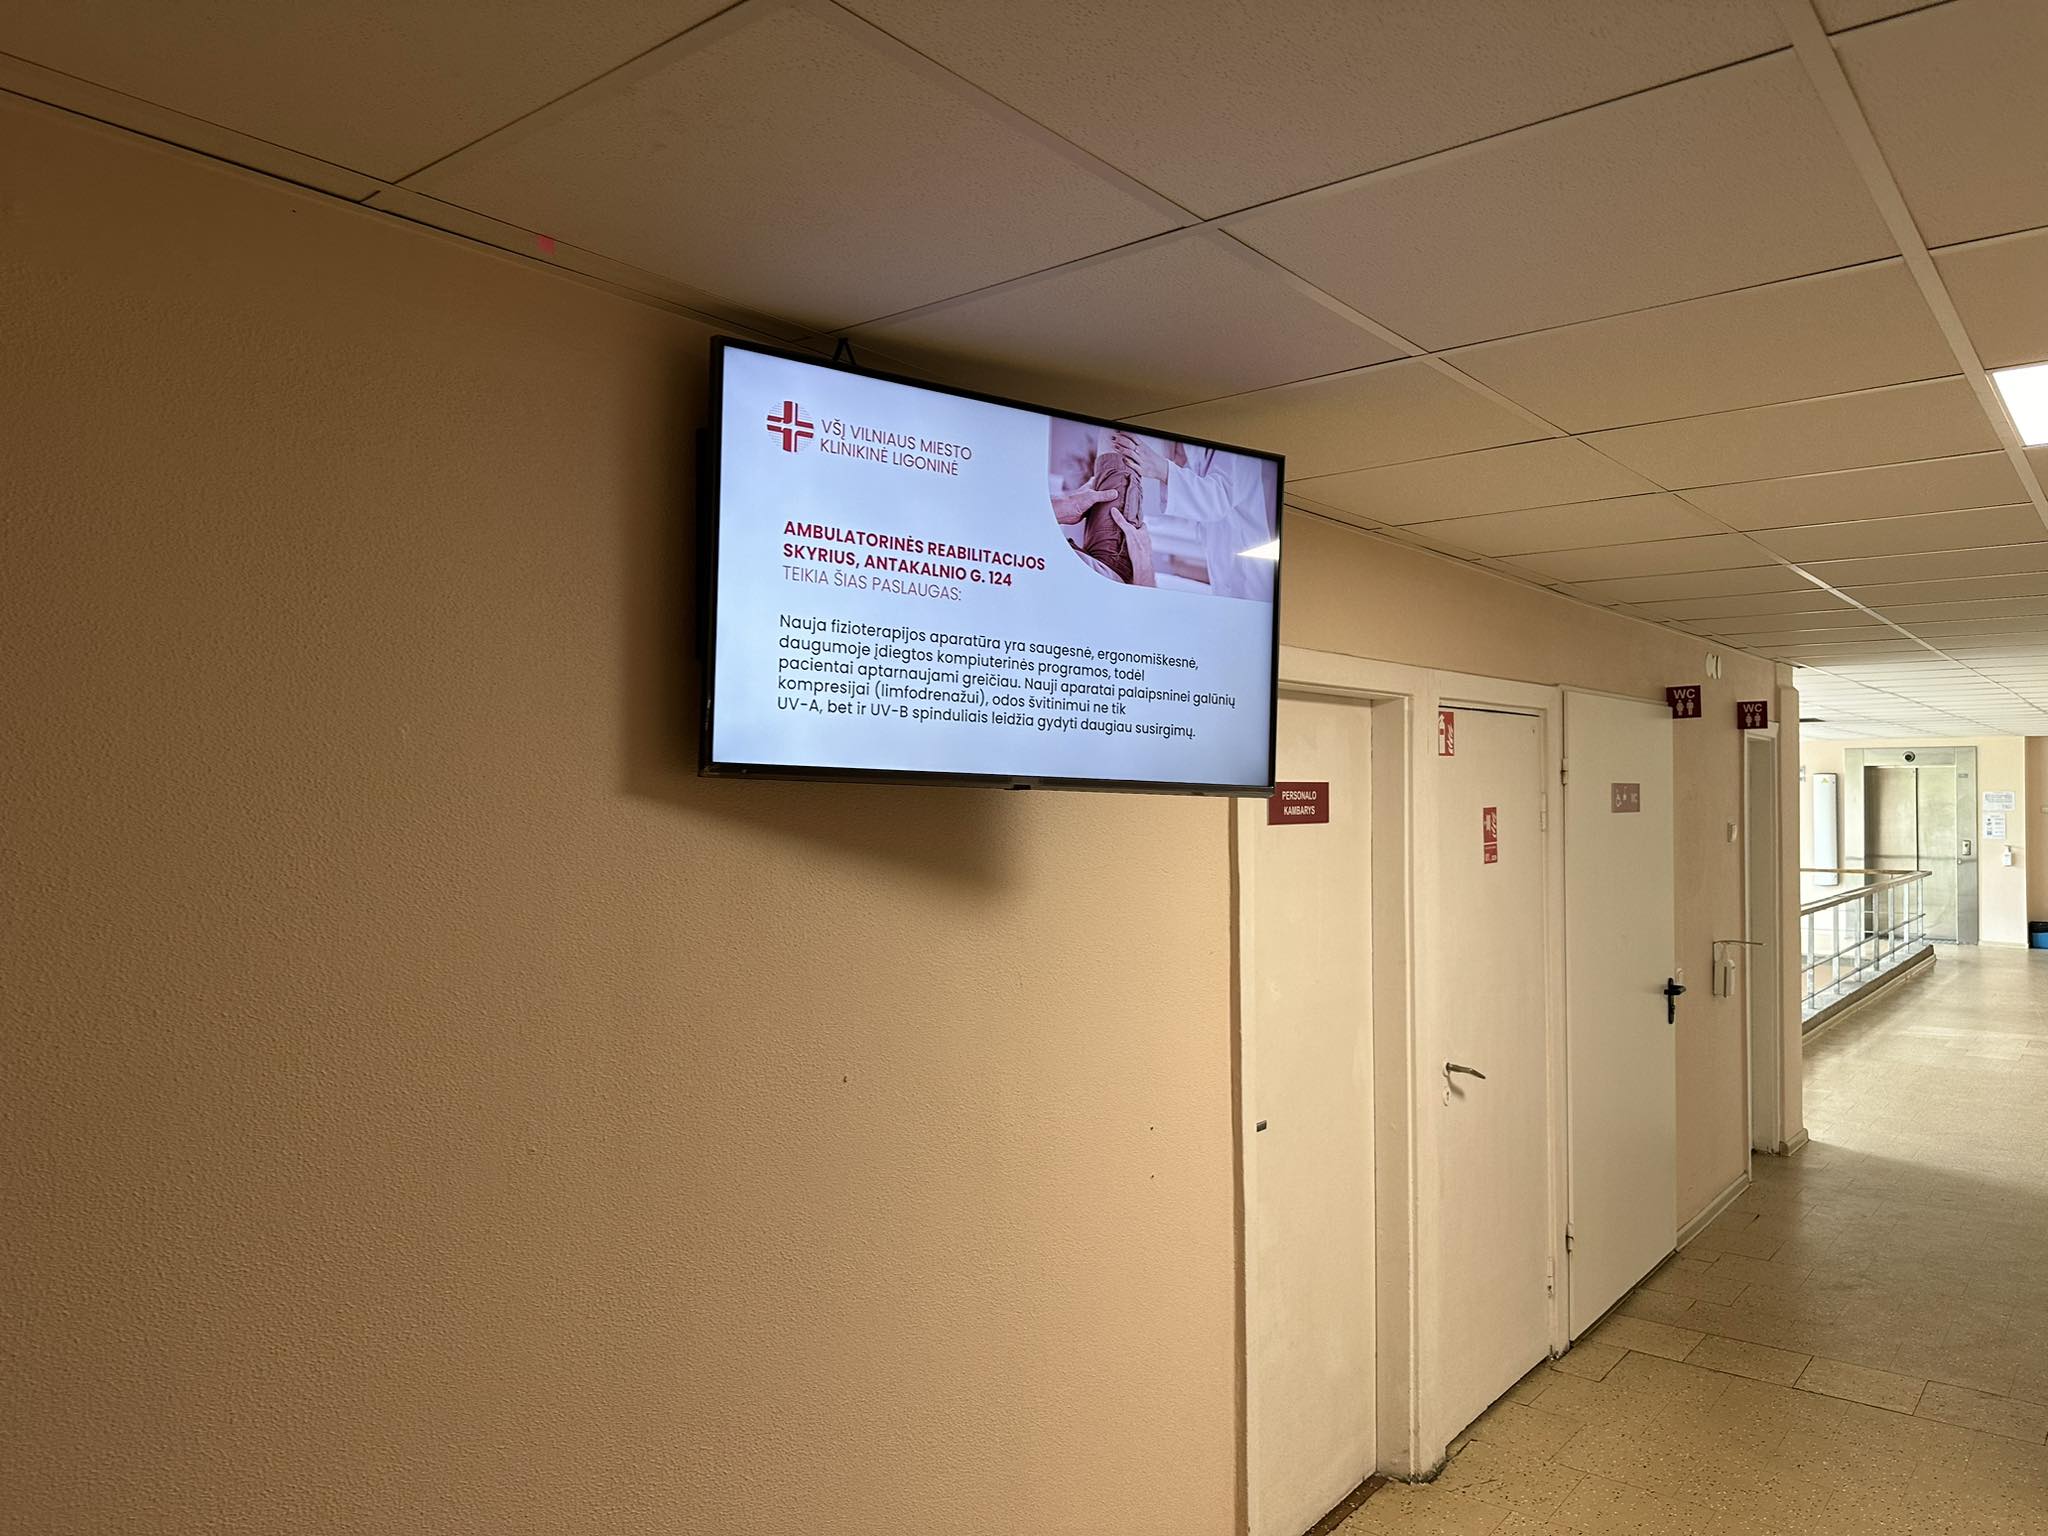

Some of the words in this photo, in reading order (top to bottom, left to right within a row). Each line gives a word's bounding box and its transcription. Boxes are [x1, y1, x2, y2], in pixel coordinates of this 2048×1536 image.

[820, 438, 888, 463] KLINIKINĖ
[892, 451, 958, 476] LIGONINĖ
[821, 419, 846, 440] VŠĮ
[850, 425, 916, 450] VILNIAUS
[920, 438, 972, 460] MIESTO
[783, 543, 860, 569] SKYRIUS,
[864, 554, 967, 580] ANTAKALNIO
[970, 568, 986, 583] G.
[989, 570, 1012, 586] 124
[784, 520, 924, 554] AMBULATORINĖS
[927, 542, 1046, 570] REABILITACIJOS
[783, 565, 829, 585] TEIKIA
[834, 569, 867, 589] ŠIAS
[872, 577, 962, 601] PASLAUGAS:
[779, 614, 827, 635] Nauja
[831, 619, 926, 644] fizioterapijos
[929, 631, 1001, 650] aparatūra
[1004, 640, 1026, 654] yra
[1029, 642, 1095, 661] saugesnė,
[1097, 649, 1199, 670] ergonomiškesnė,
[779, 635, 871, 660] daugumoje
[874, 643, 933, 664] įdiegtos
[937, 650, 1035, 671] kompiuterinės
[1038, 661, 1111, 680] programos,
[1114, 668, 1145, 681] todėl
[778, 657, 854, 675] pacientai
[858, 663, 959, 685] aptarnaujami
[962, 670, 1021, 689] greičiau.
[1024, 677, 1058, 695] Nauji
[1060, 681, 1115, 697] aparatai
[1118, 686, 1191, 703] palaipsninei
[1192, 692, 1236, 709] galūnių
[778, 675, 870, 698] kompresijai
[874, 680, 989, 707] (limfodrenažui),
[992, 693, 1025, 708] odos
[1028, 696, 1090, 712] švitinimui
[1093, 703, 1109, 714] ne
[1111, 703, 1127, 715] tik
[1673, 688, 1696, 699] WC
[777, 696, 823, 714] UV-A,
[827, 700, 853, 714] bet
[857, 702, 867, 715] ir
[870, 703, 909, 718] UV-B
[912, 707, 988, 724] spinduliais
[991, 711, 1034, 727] leidžia
[1037, 715, 1077, 731] gydyti
[1080, 718, 1132, 735] daugiau
[1135, 722, 1196, 740] susirgimų.
[1743, 703, 1763, 713] WC
[1281, 790, 1317, 800] PERSONALO
[1283, 805, 1316, 816] KAMBARYS
